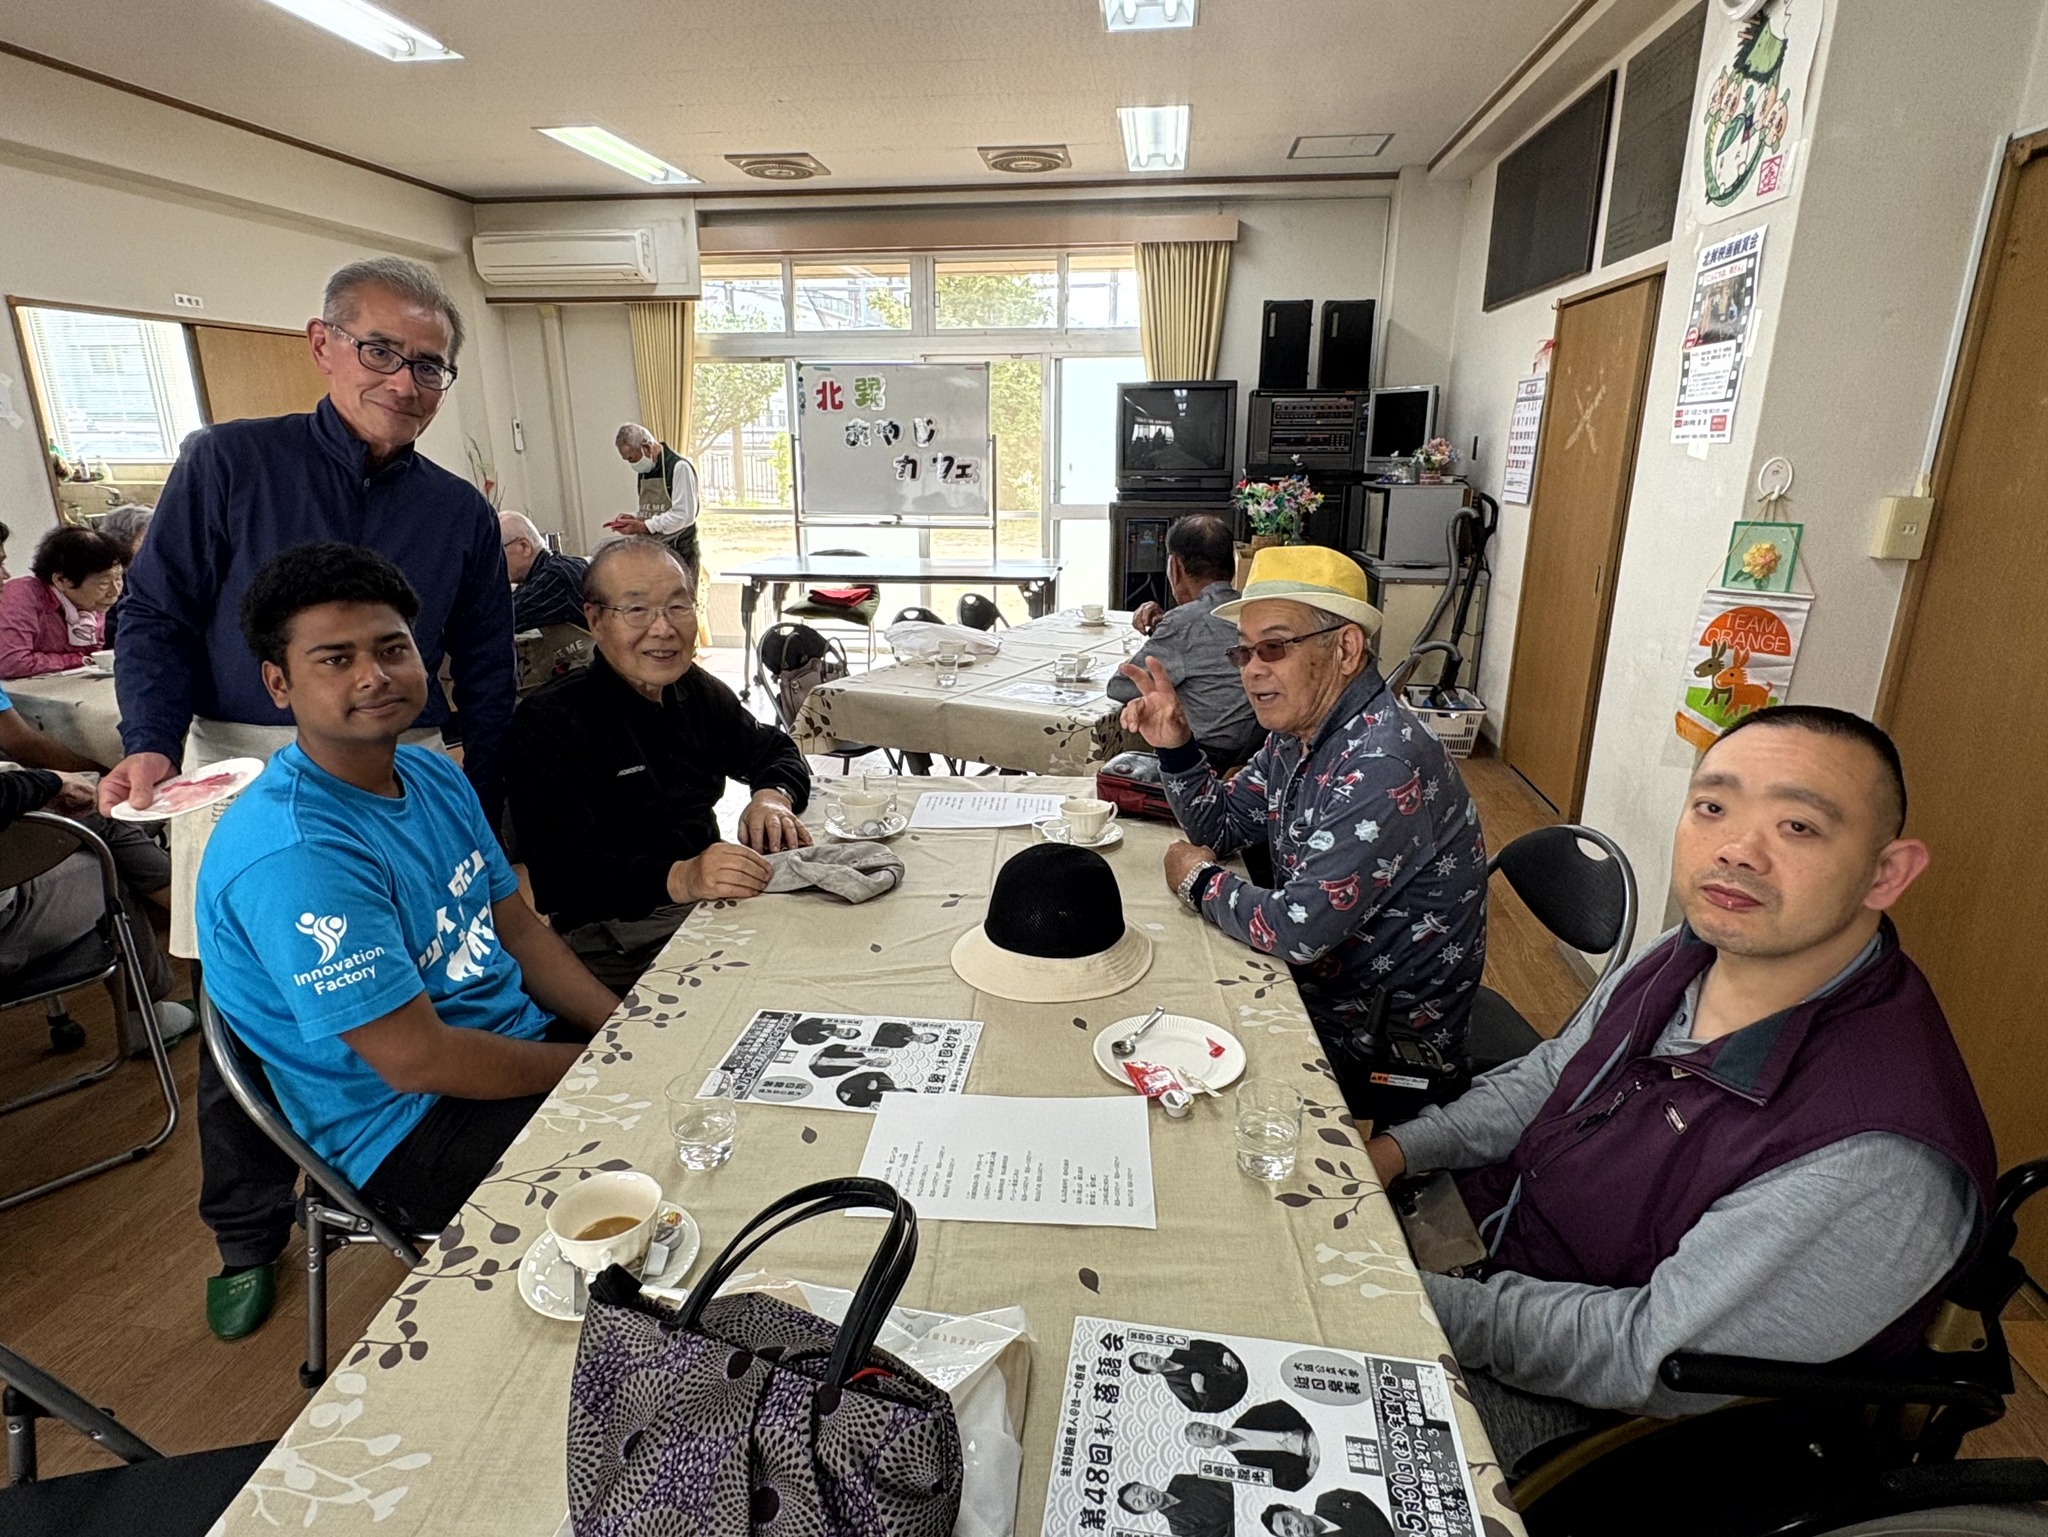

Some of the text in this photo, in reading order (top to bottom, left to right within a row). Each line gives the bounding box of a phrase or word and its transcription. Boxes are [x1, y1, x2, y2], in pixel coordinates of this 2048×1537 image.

[845, 418, 936, 447] おやじ
[894, 453, 973, 480] カフェ
[1725, 612, 1779, 634] TEAM
[1704, 627, 1789, 654] ORANGE
[293, 945, 386, 987] Innovation
[313, 964, 377, 995] Factory
